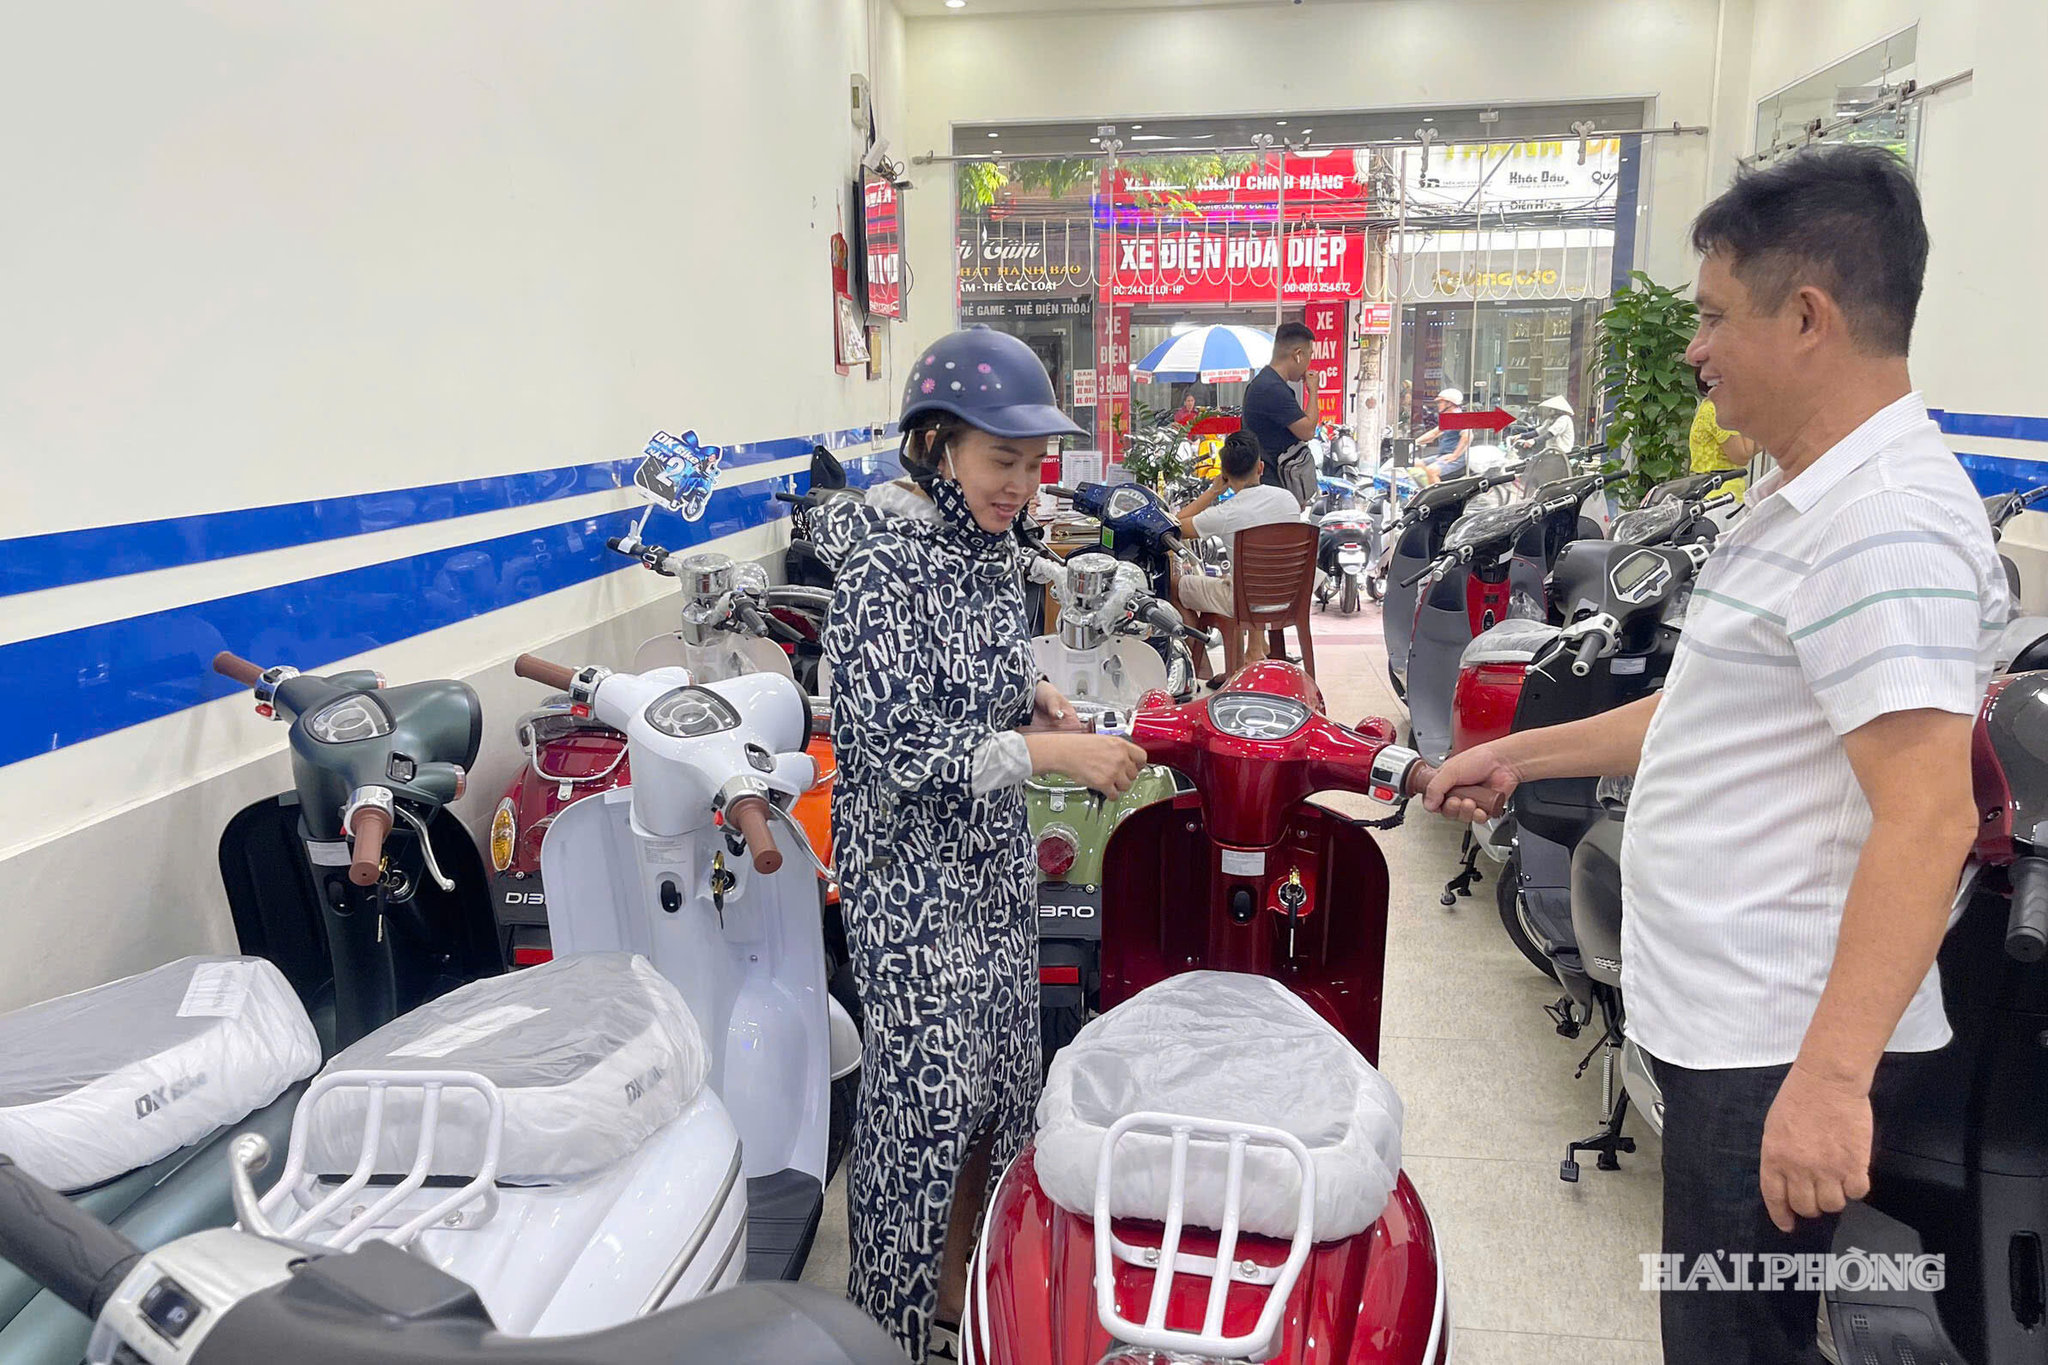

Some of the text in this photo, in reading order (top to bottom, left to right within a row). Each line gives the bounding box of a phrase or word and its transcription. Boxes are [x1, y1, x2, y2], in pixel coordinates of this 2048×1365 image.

[1246, 173, 1294, 190] CHÍNH
[1120, 229, 1347, 275] XE ĐIỆN HÒA DIỆP
[961, 302, 974, 317] HẺ
[976, 304, 1006, 316] GAME
[1014, 302, 1033, 315] THẺ
[1104, 315, 1122, 335] XE
[1316, 311, 1334, 330] XE
[1100, 342, 1127, 367] ĐIỆN
[1311, 337, 1337, 360] MÁY
[1099, 374, 1105, 394] 3
[655, 456, 686, 488] 2
[504, 892, 545, 905] DIB
[1043, 909, 1120, 927] BAO
